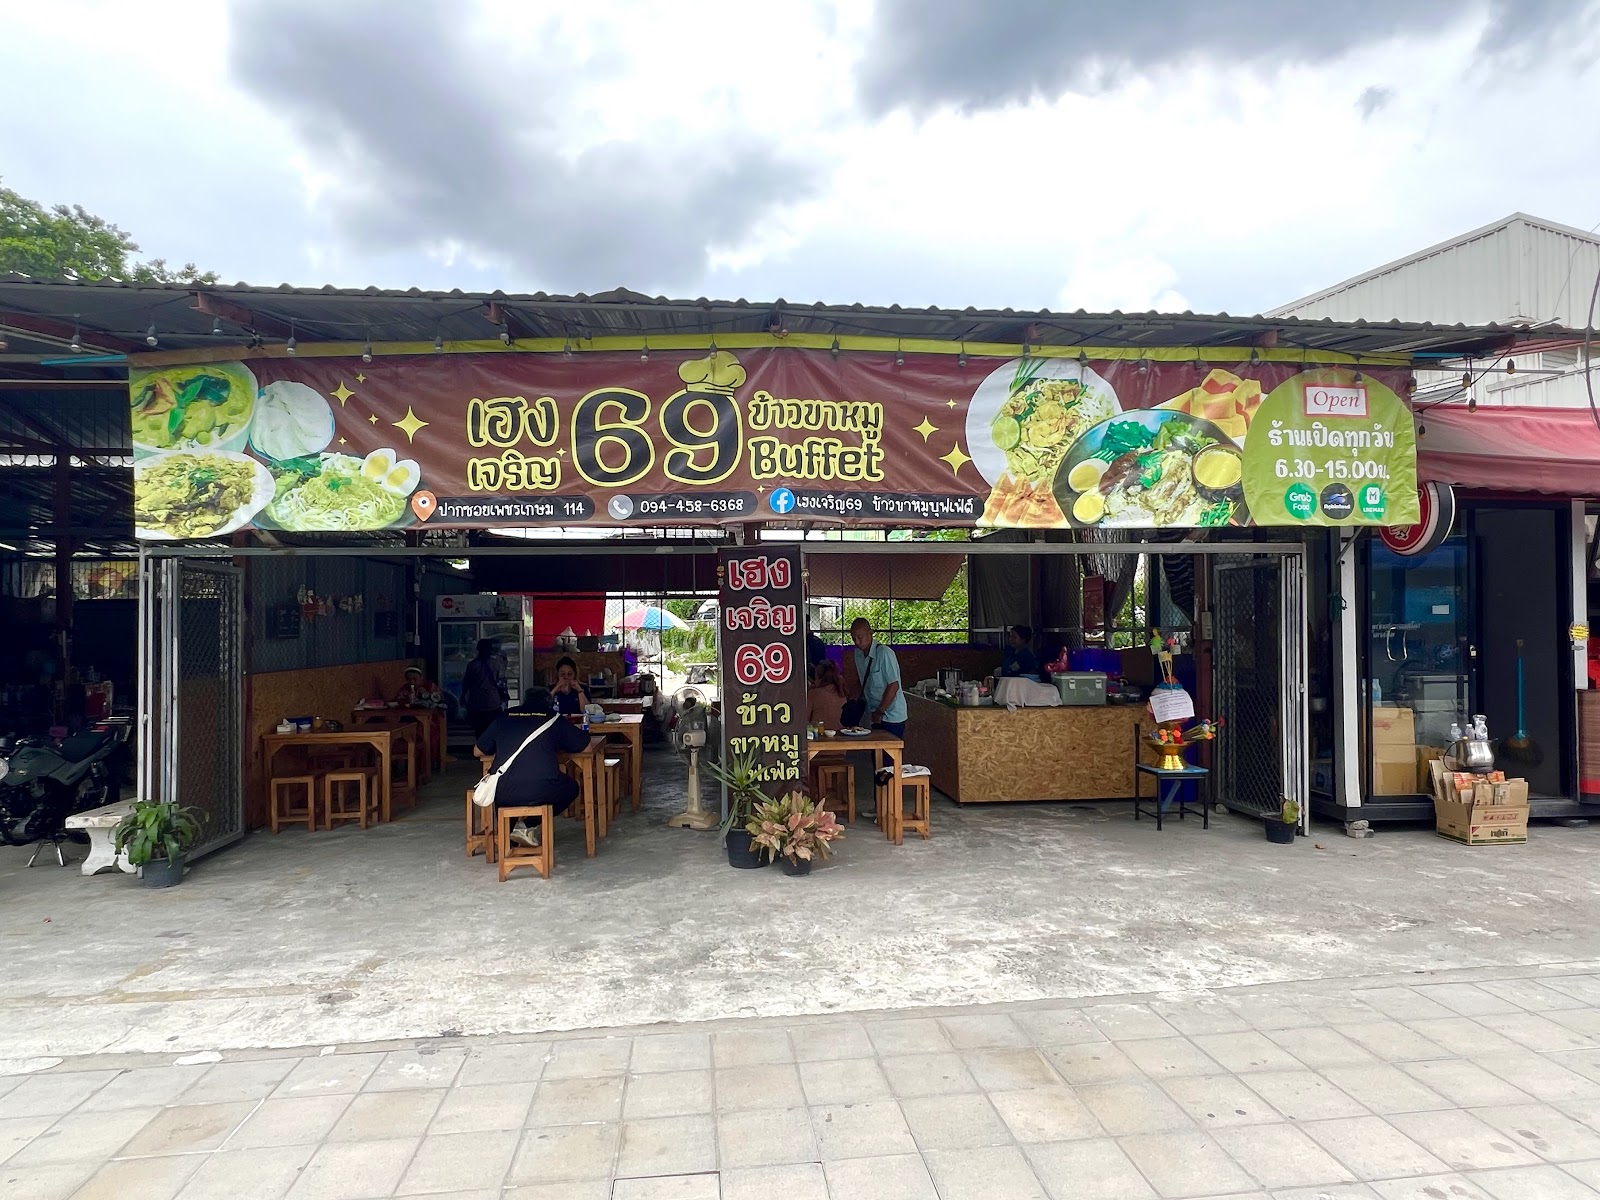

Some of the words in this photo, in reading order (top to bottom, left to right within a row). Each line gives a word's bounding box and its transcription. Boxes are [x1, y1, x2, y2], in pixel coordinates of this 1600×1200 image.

[748, 390, 884, 444] ข้าวขาหมู
[1313, 390, 1361, 412] Open
[467, 396, 560, 448] เฮง
[570, 387, 744, 487] 69
[1268, 420, 1395, 457] ร้านเปิดทุกวัน
[467, 449, 562, 491] เจริญ
[747, 435, 885, 482] Buffet
[1275, 458, 1391, 480] 6.30-15.00น.
[438, 502, 554, 517] ปากซอยเพชรเกษม
[563, 502, 585, 516] 114
[640, 499, 744, 513] 094-458-6368
[796, 495, 863, 514] เฮงเจริญ69
[1289, 492, 1312, 502] Grab
[1292, 503, 1310, 511] Food
[728, 556, 791, 590] เฮง
[725, 596, 797, 635] เจริญ
[734, 642, 793, 685] 69
[736, 692, 791, 726] ข้าว
[730, 734, 799, 759] ขาหมู
[746, 759, 800, 782] ฟเฟ่ต์
